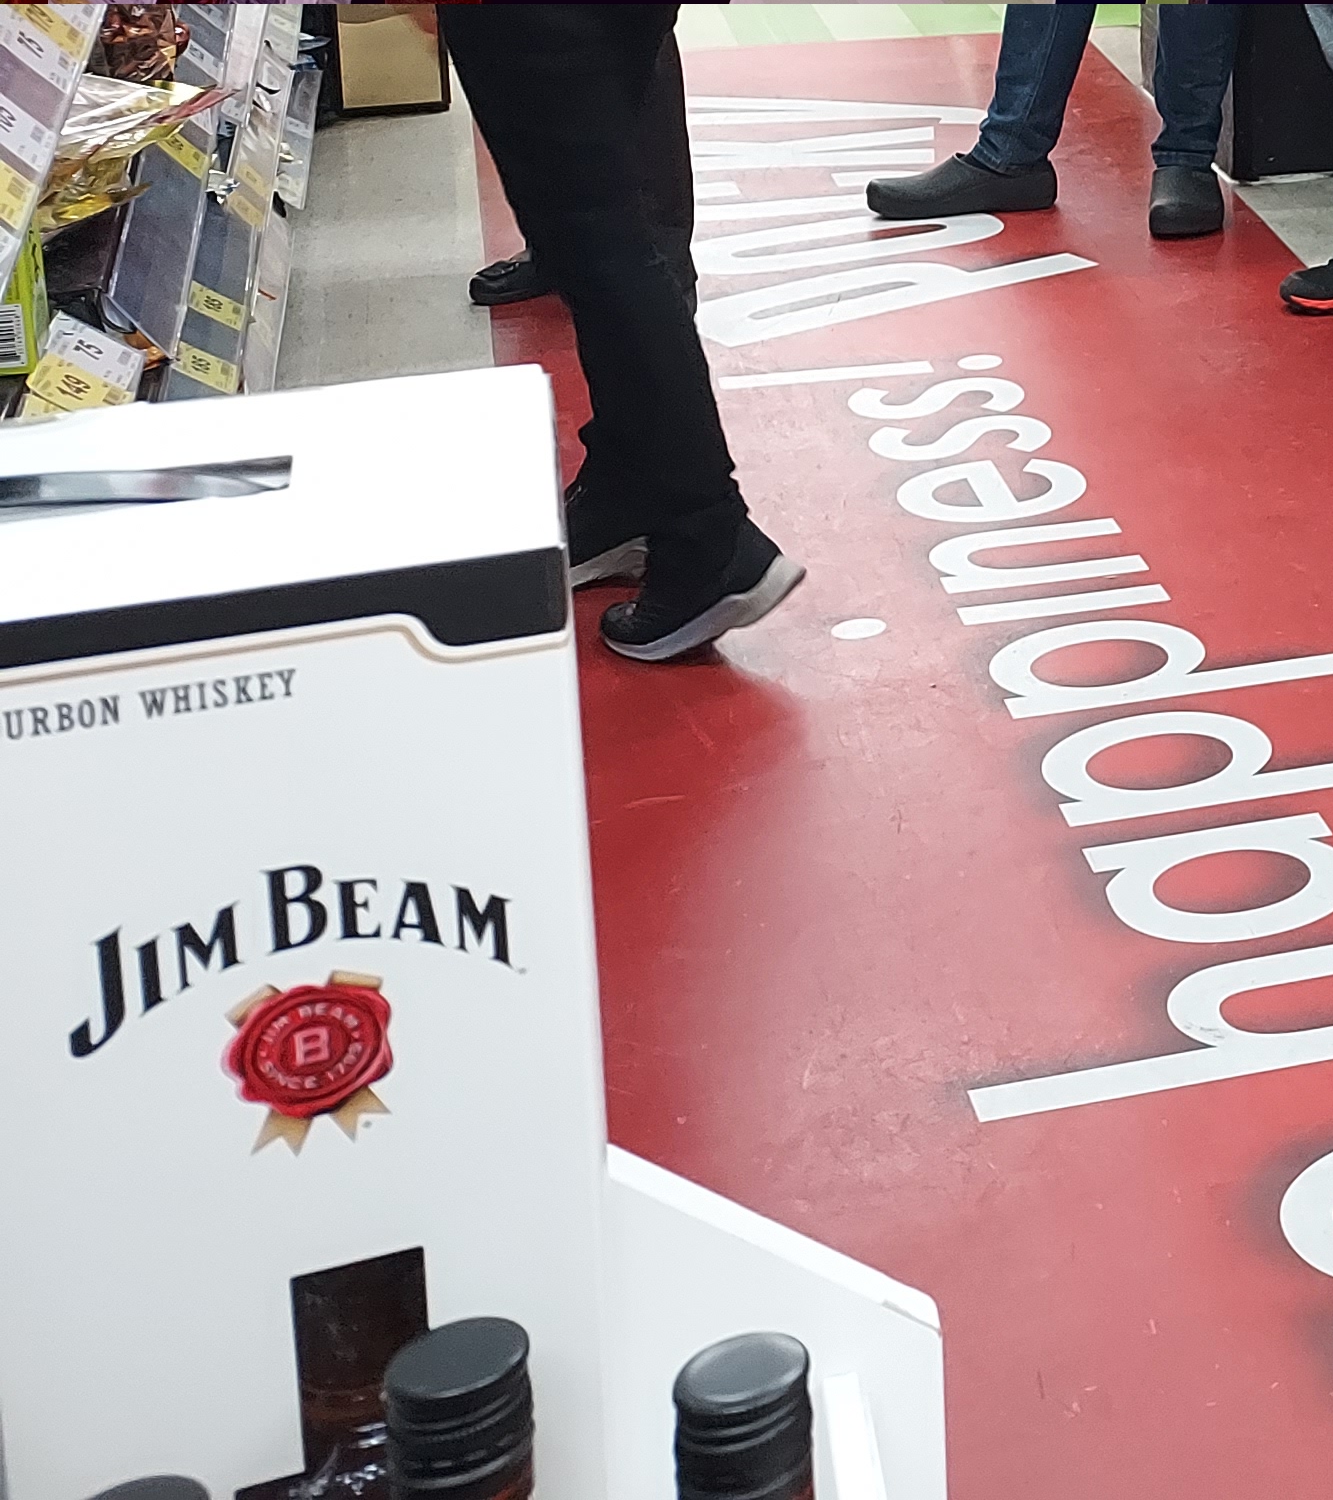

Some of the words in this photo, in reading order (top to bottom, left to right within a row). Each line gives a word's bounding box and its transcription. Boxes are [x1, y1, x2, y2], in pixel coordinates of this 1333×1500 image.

[72, 337, 104, 362] 75
[55, 371, 92, 402] 149
[138, 668, 298, 721] WHISKEY
[69, 900, 241, 1061] JIM
[260, 864, 519, 969] BEAM
[293, 1027, 331, 1067] B
